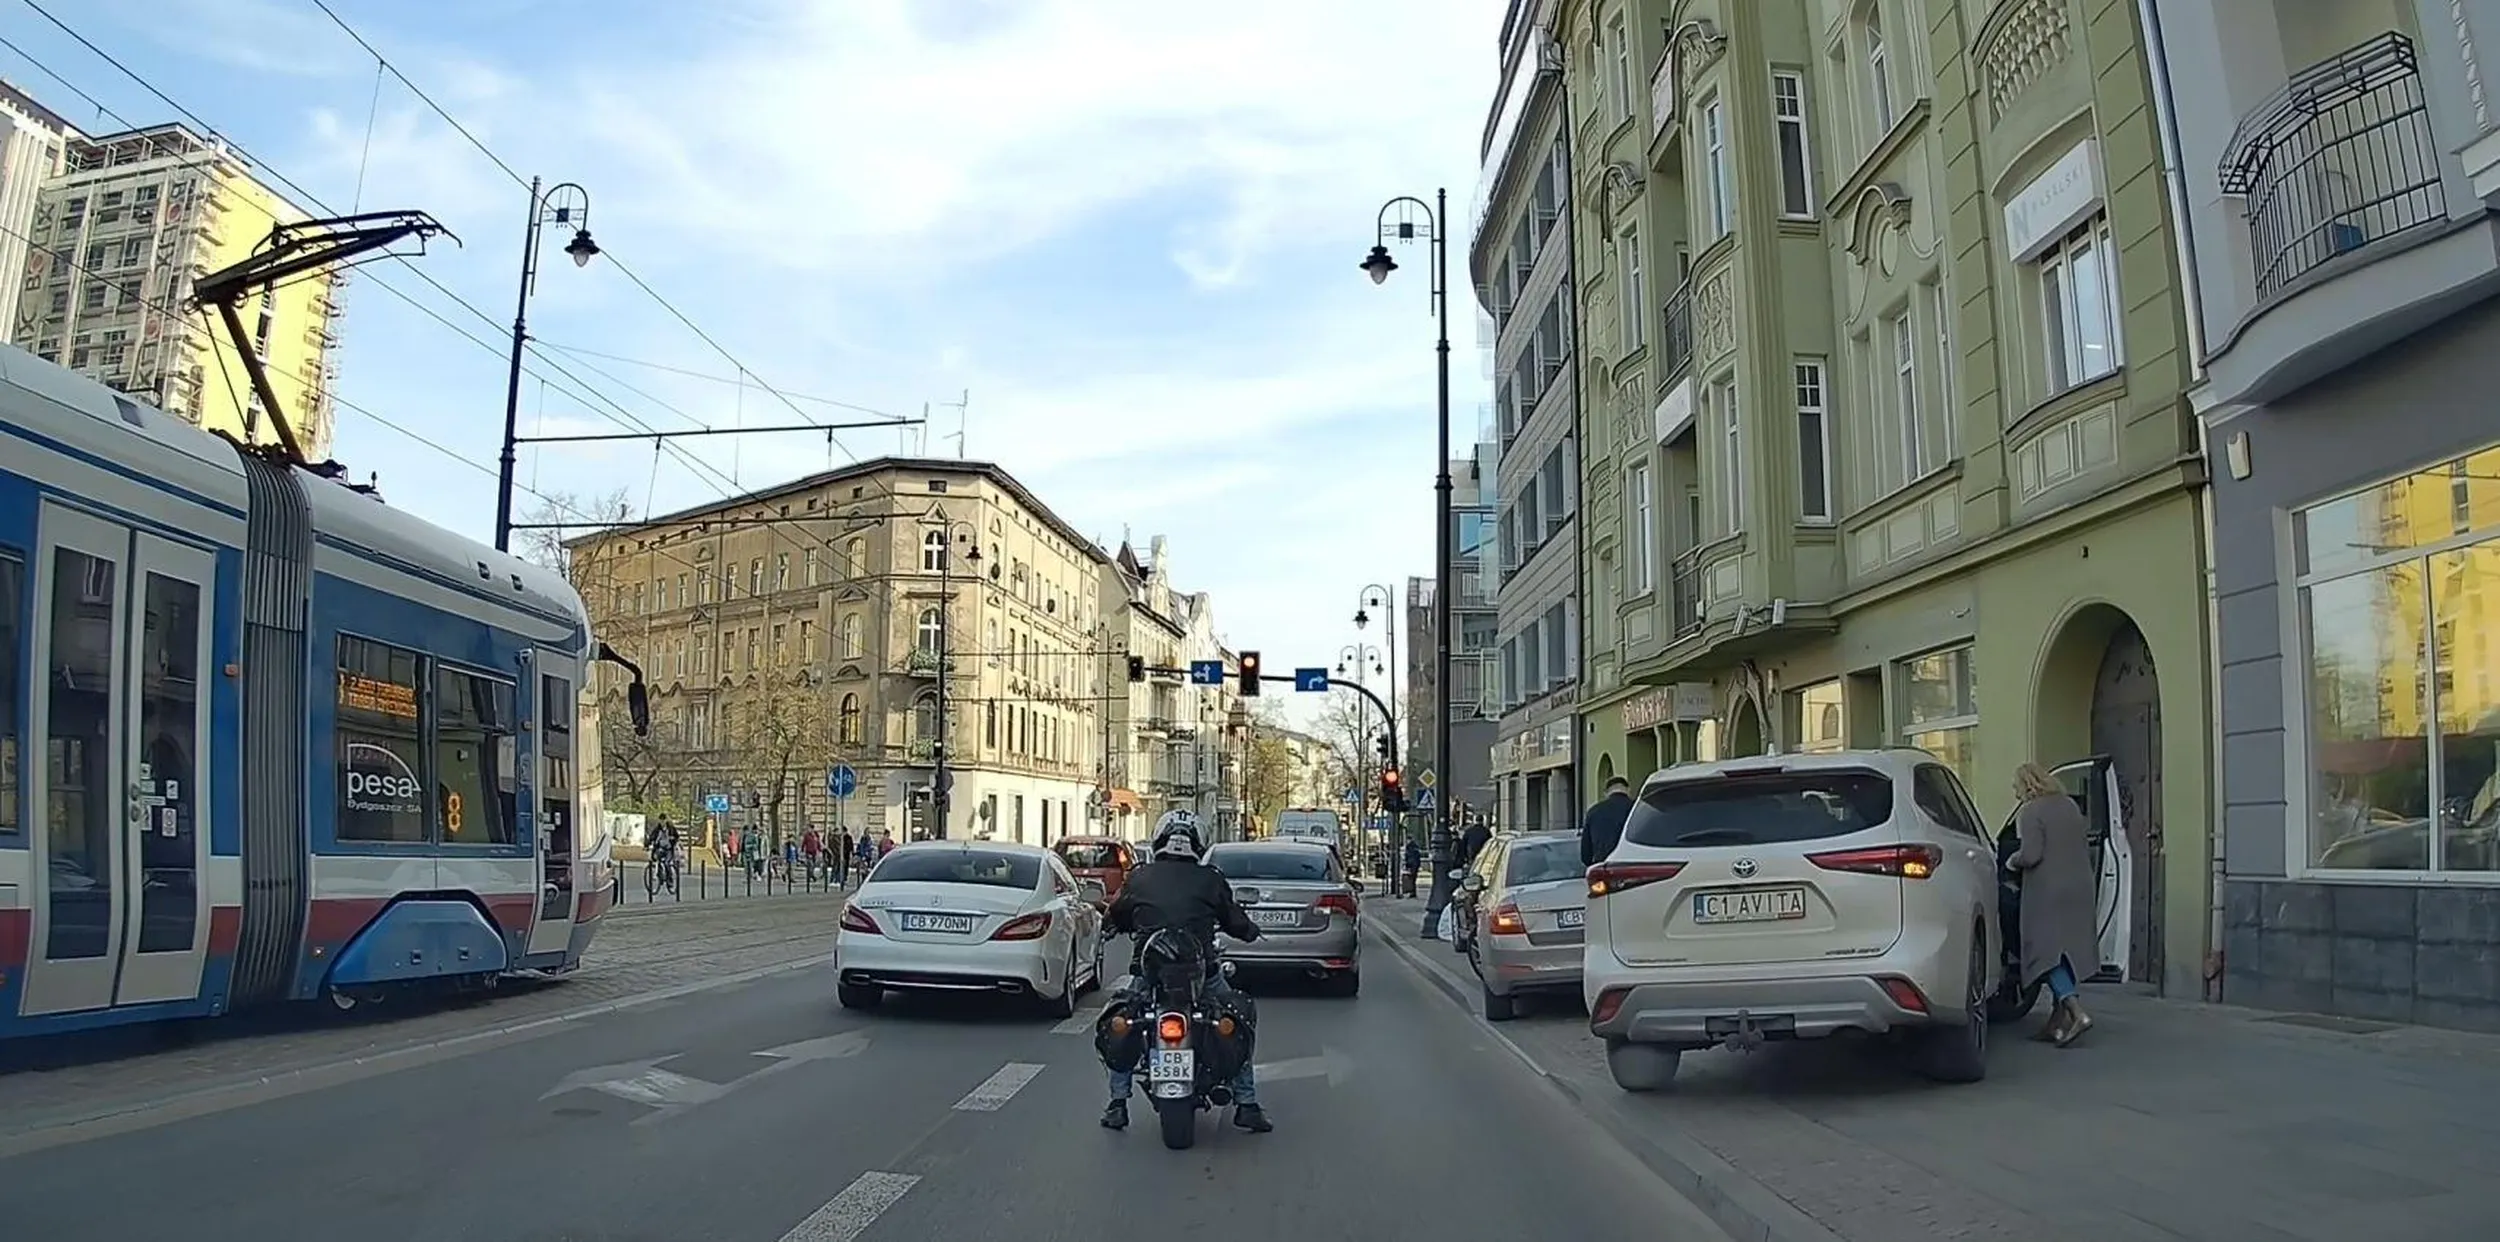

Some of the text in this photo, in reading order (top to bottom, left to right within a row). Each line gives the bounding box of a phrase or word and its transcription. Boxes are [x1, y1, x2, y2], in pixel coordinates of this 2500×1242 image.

[347, 771, 413, 799] pesa
[347, 799, 402, 813] Bydgoszcz
[448, 792, 462, 833] 8
[1707, 892, 1801, 916] C1 AVITA
[910, 915, 968, 929] CB 970NM
[1164, 1052, 1182, 1064] CB
